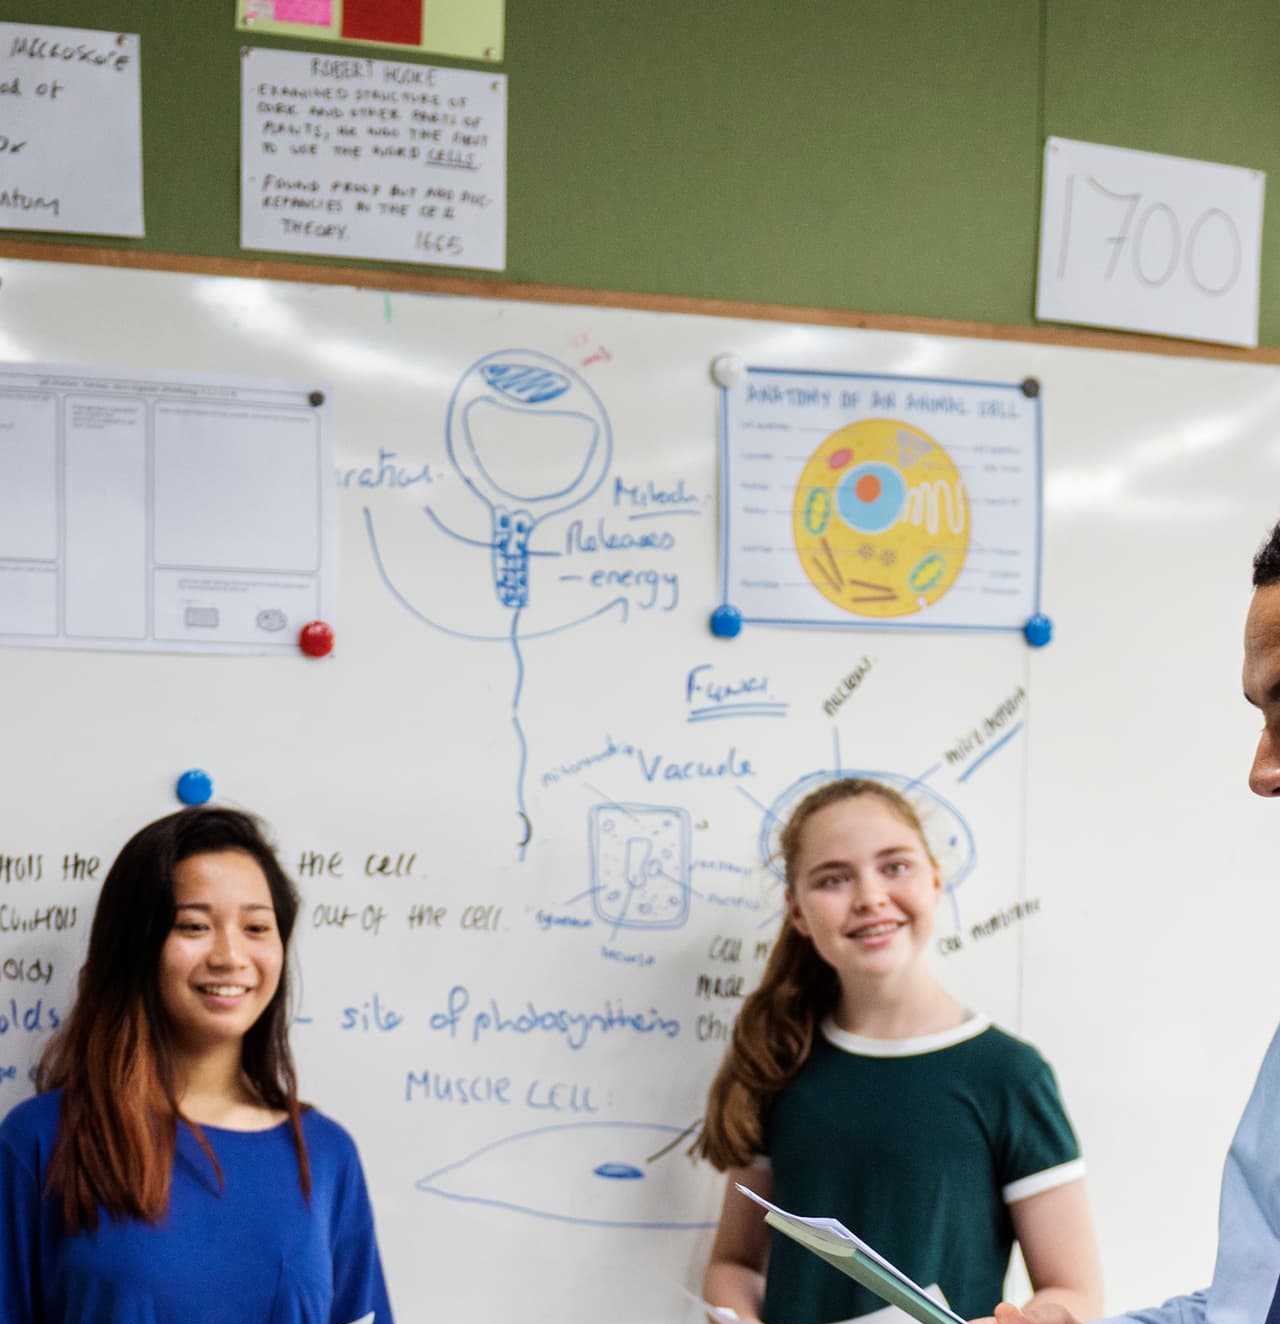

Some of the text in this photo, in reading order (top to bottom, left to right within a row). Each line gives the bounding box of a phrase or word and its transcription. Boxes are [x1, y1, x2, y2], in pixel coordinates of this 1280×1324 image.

[309, 57, 439, 88] ROBERT HOOKE
[35, 79, 64, 100] of
[409, 128, 443, 143] THE
[333, 145, 361, 159] THE
[378, 202, 411, 218] THE
[1055, 172, 1243, 297] 1700
[745, 382, 830, 410] ANATOMY
[838, 389, 860, 411] OF
[589, 569, 680, 613] energy
[62, 851, 102, 883] the
[428, 984, 470, 1039] of
